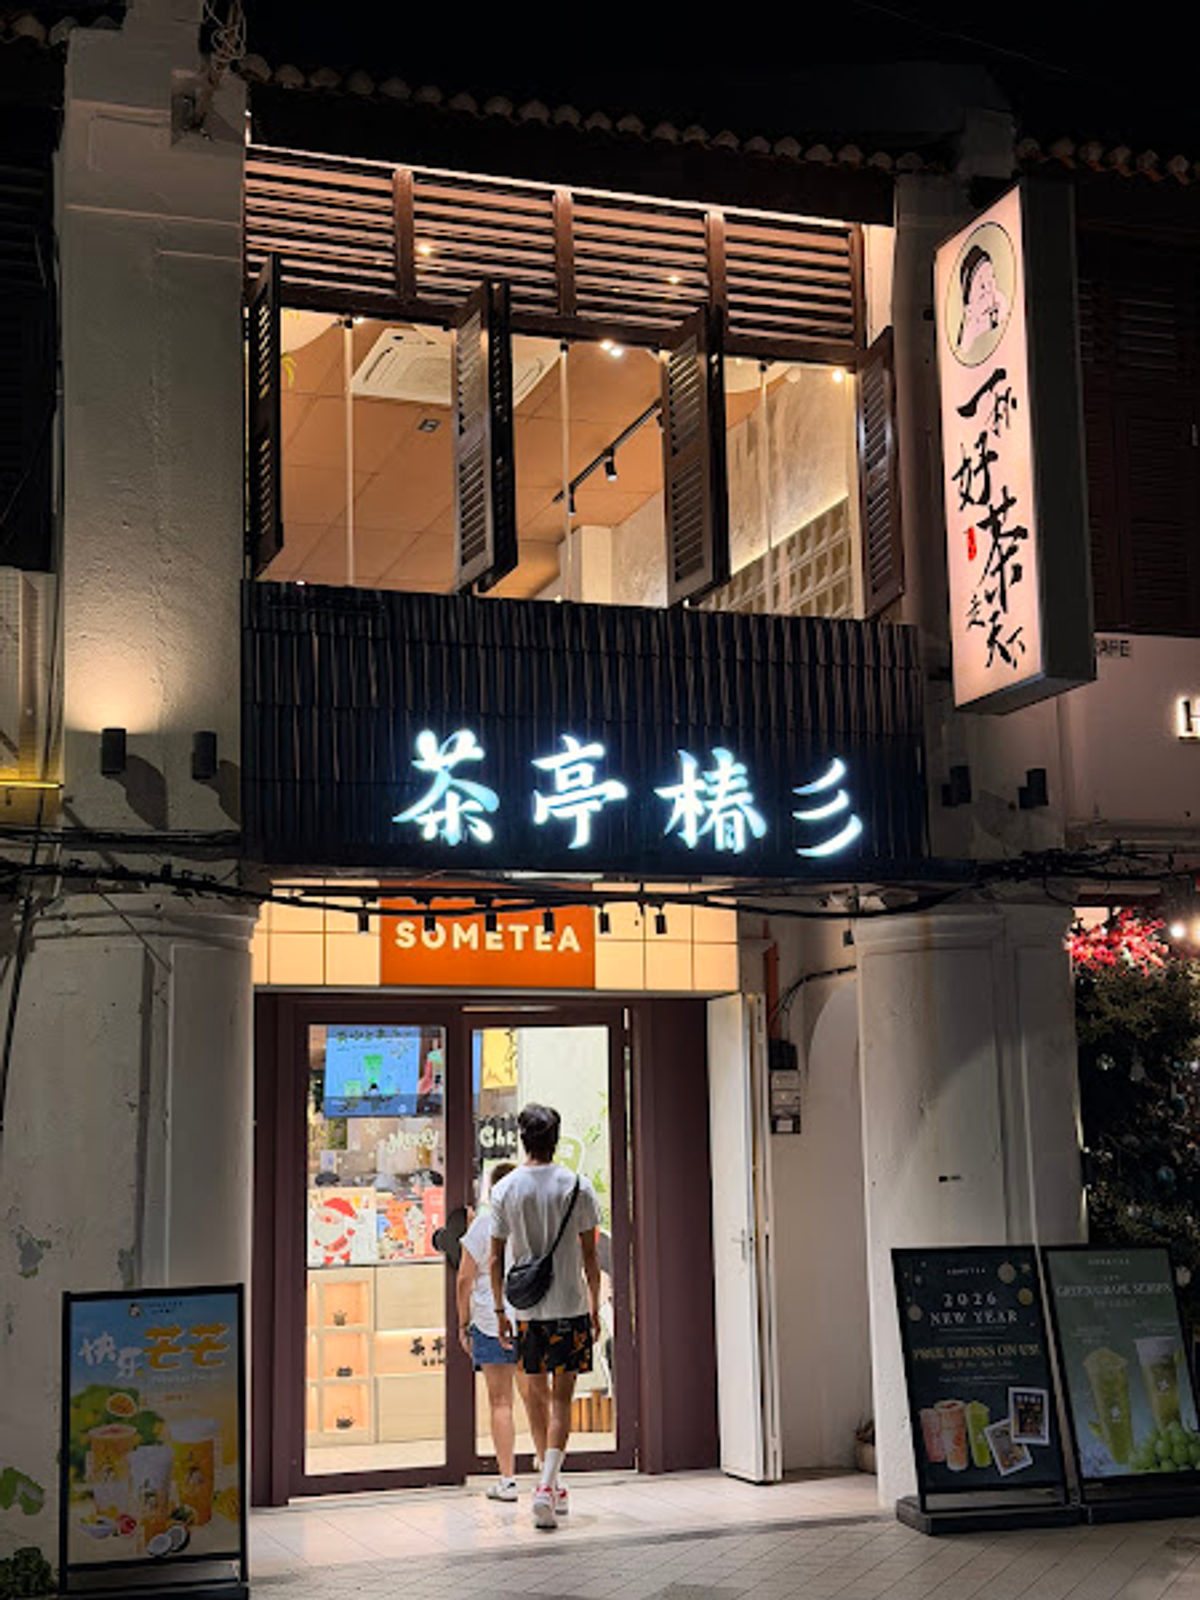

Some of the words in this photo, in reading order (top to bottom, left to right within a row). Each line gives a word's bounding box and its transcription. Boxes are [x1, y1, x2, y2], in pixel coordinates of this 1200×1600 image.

[1094, 638, 1130, 657] AFE
[395, 920, 581, 953] SOMETEA
[943, 1291, 997, 1308] 2026
[929, 1311, 967, 1327] NEW
[973, 1309, 1019, 1325] YEAR
